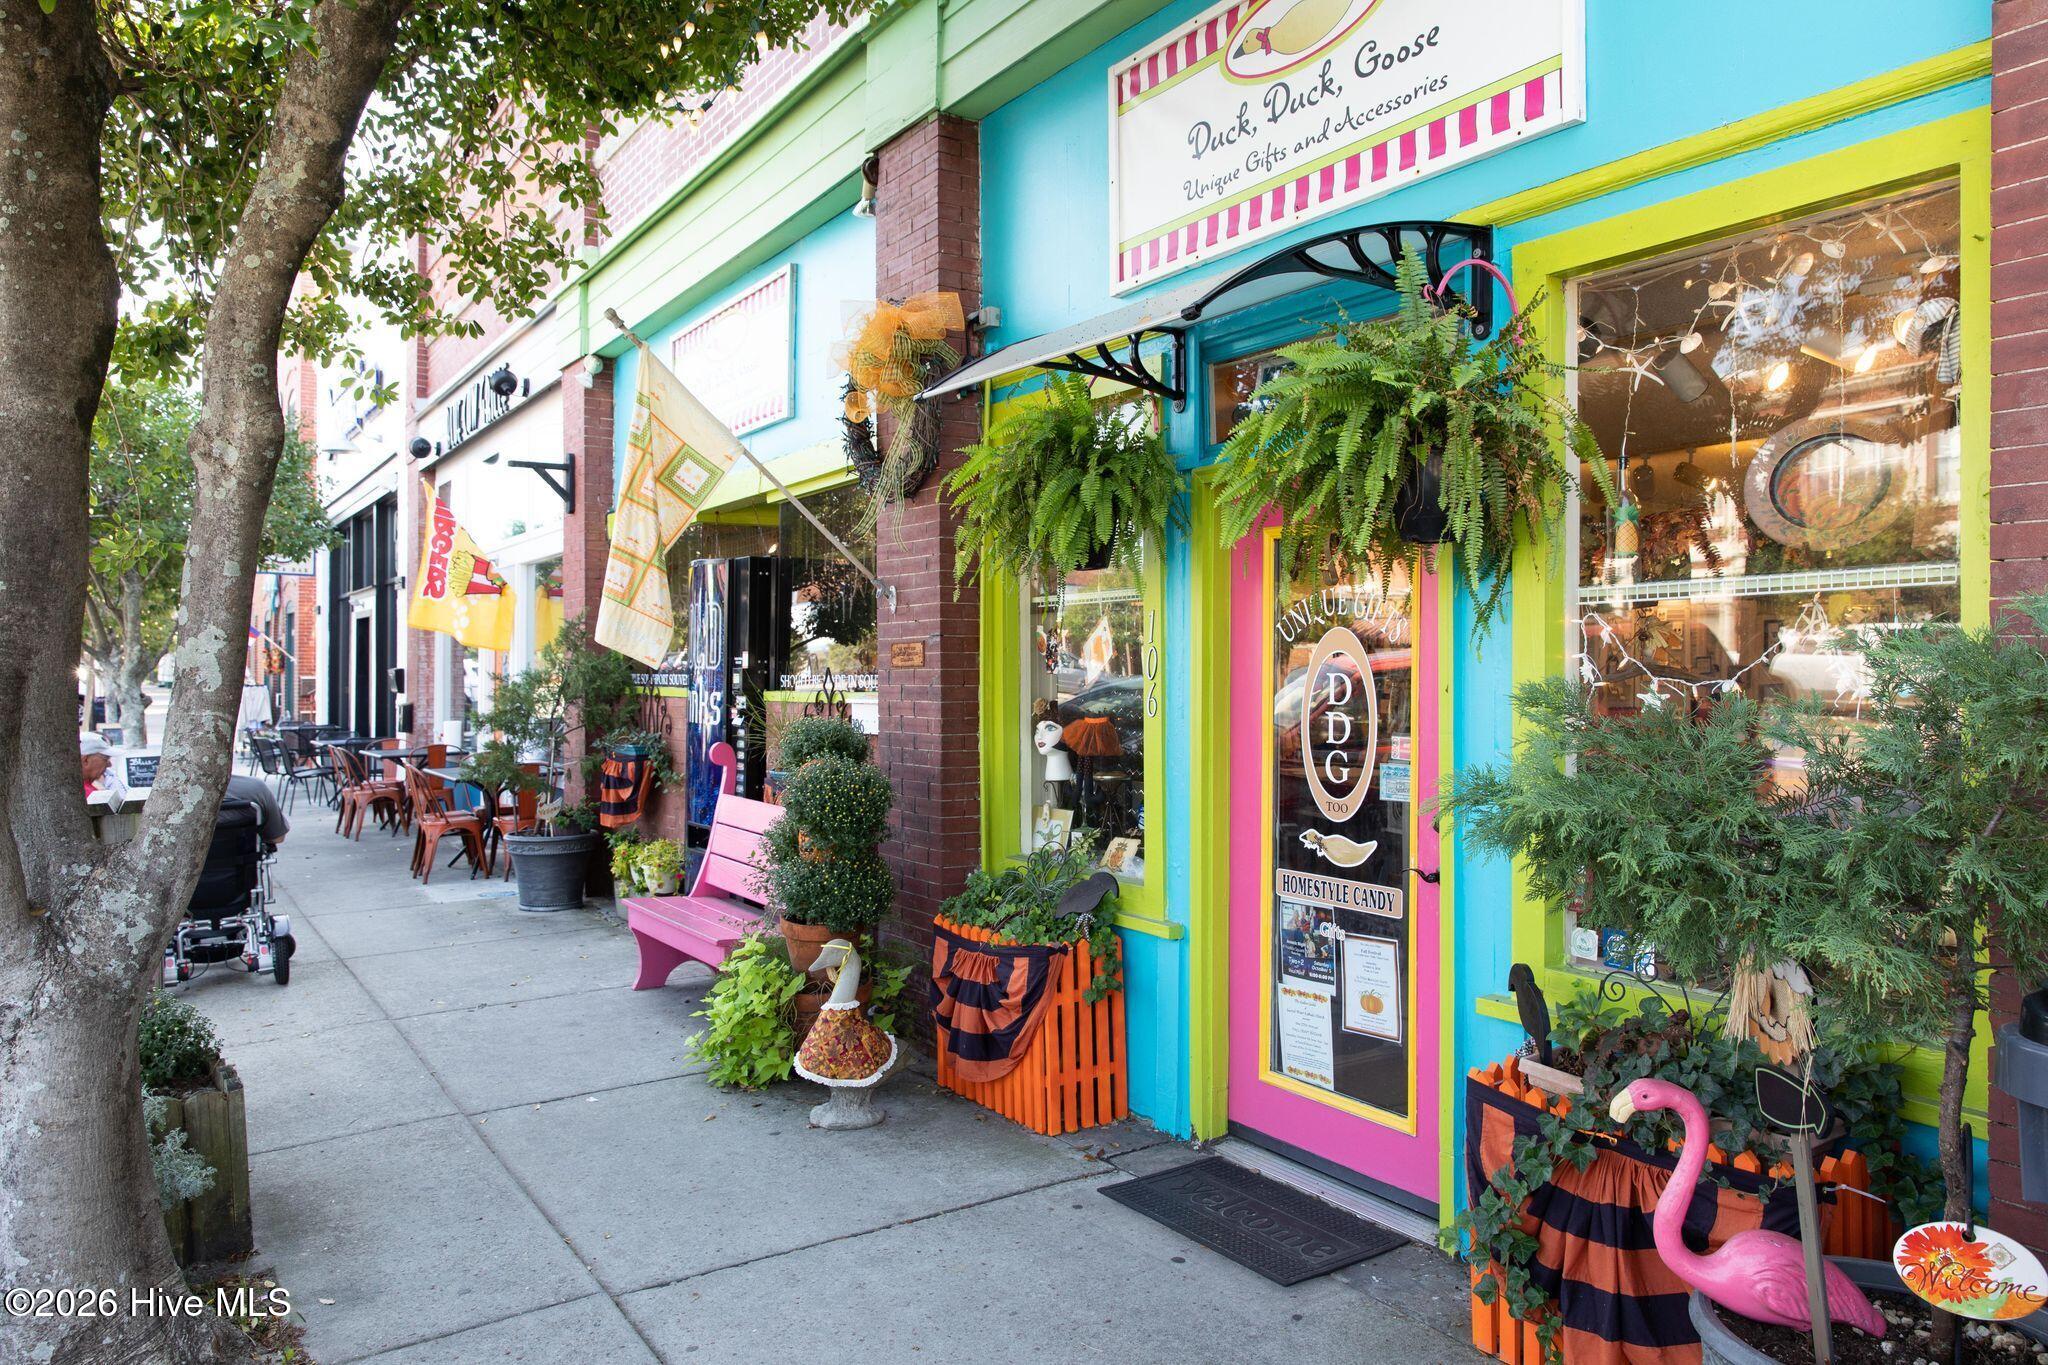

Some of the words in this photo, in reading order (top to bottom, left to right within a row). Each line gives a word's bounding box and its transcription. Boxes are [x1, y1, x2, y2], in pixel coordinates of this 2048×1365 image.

[1188, 101, 1258, 160] Duck,
[1263, 59, 1343, 124] Duck,
[1354, 26, 1440, 78] Goose
[1184, 167, 1240, 201] Unique
[1246, 143, 1287, 173] Gifts
[1293, 117, 1331, 153] and
[1334, 72, 1449, 132] Accessories
[1354, 588, 1408, 643] GIFTS
[1326, 800, 1349, 814] TOO
[1282, 874, 1349, 904] HOMESTYLE
[1353, 886, 1395, 912] CANDY
[1901, 1261, 2048, 1302] Welcome
